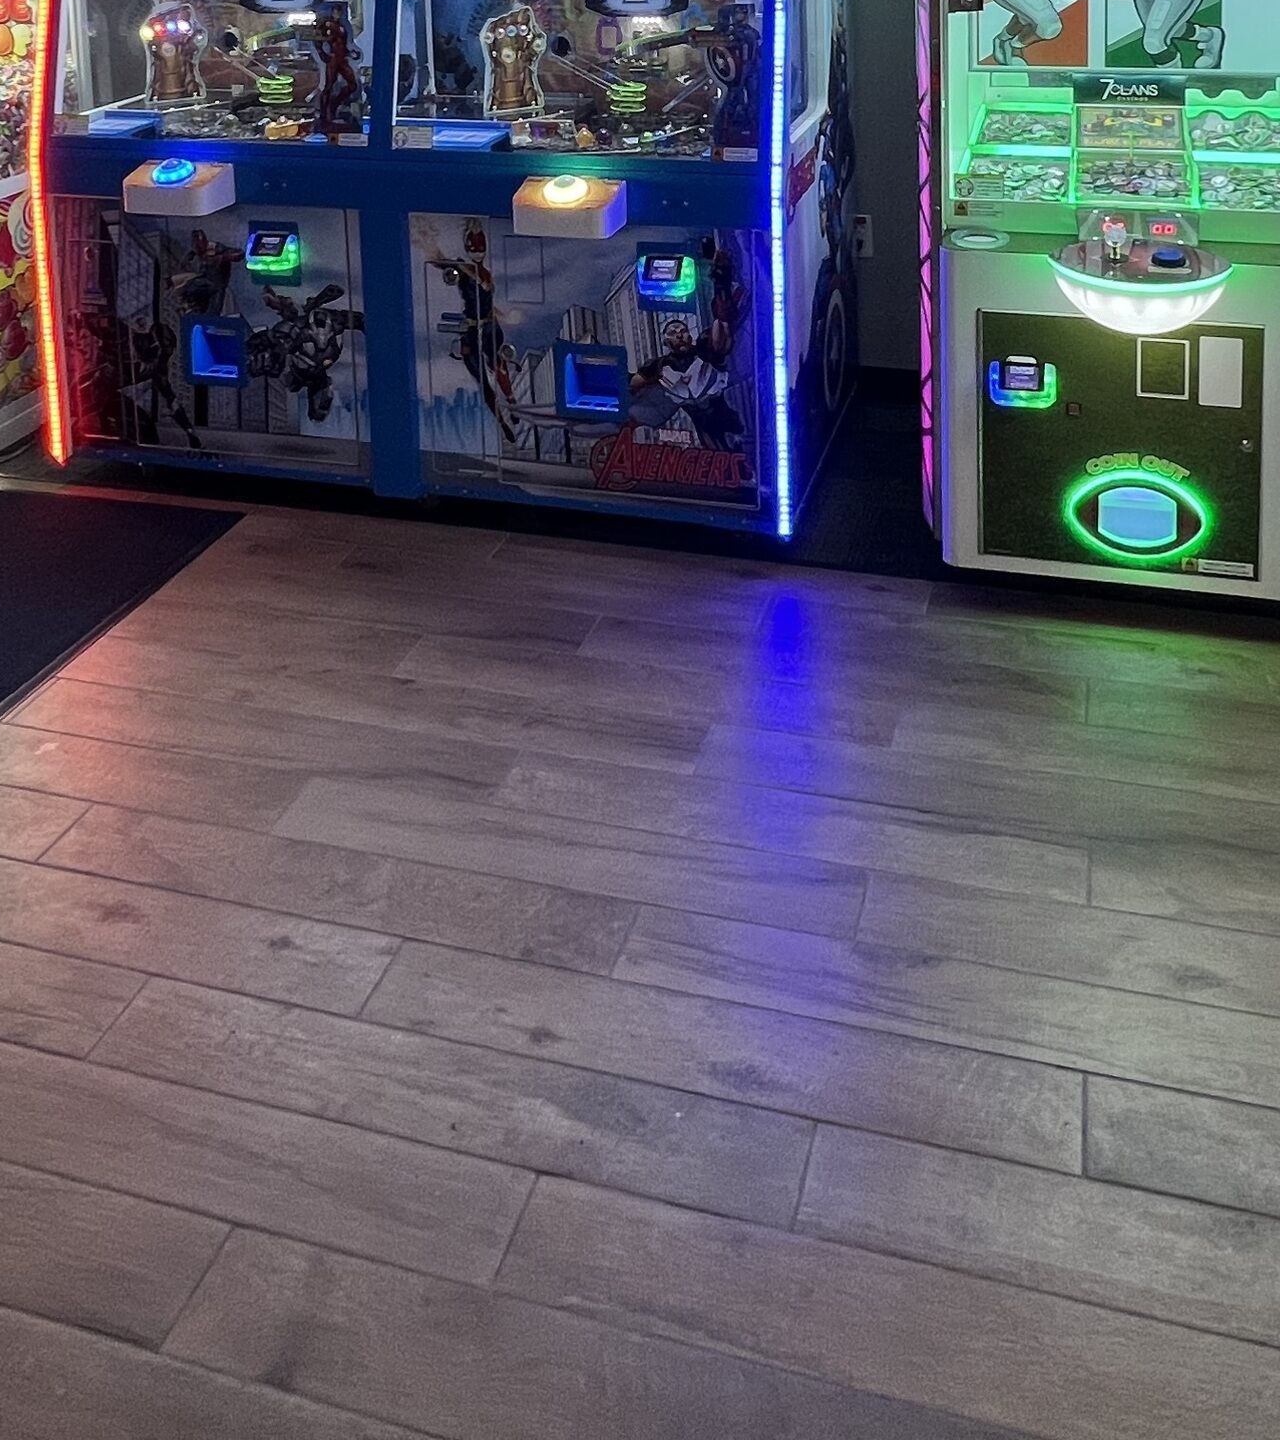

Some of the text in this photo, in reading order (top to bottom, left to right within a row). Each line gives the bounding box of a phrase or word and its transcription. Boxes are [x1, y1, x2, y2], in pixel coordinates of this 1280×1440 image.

[591, 427, 746, 490] AVENGERS
[1086, 453, 1191, 482] COIN OUT
